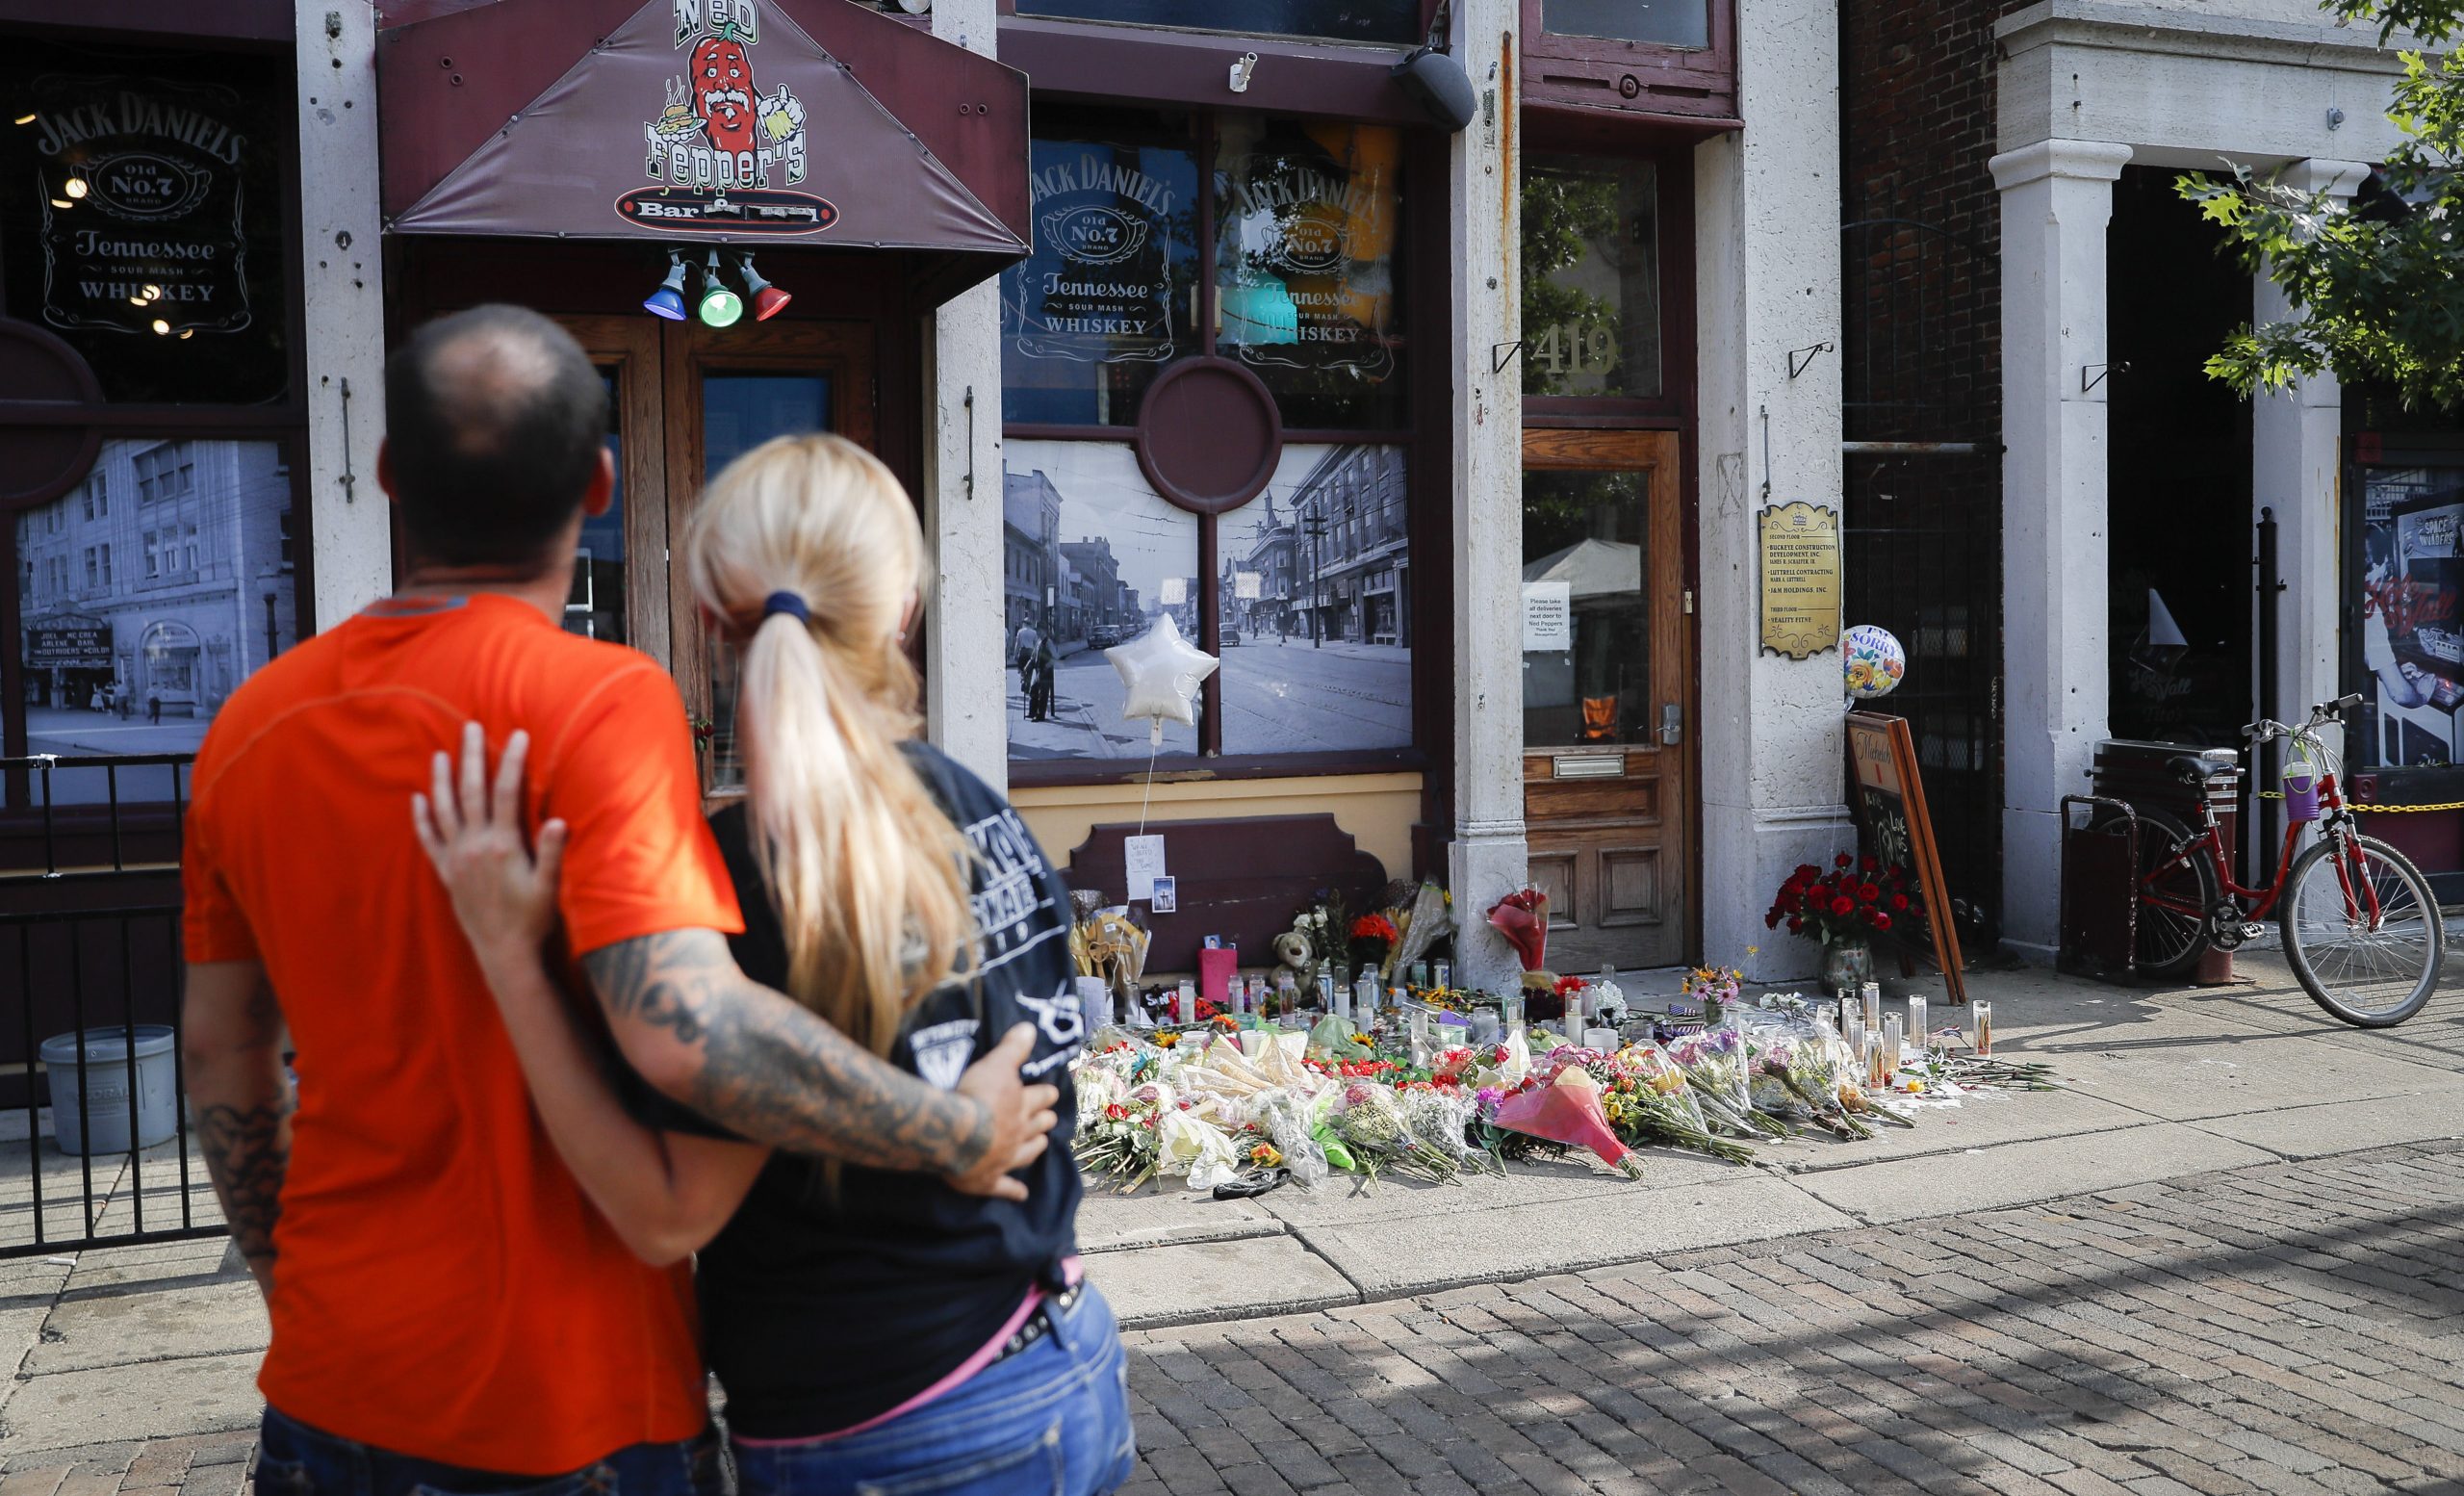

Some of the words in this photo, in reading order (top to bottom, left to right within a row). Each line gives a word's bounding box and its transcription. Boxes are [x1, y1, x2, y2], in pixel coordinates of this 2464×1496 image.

[38, 101, 117, 156] JACK
[124, 164, 157, 176] Old
[1081, 153, 1176, 217] DANIEL'S
[1237, 174, 1296, 220] JACK
[636, 201, 700, 219] Bar
[1082, 216, 1106, 226] Old
[1299, 228, 1322, 237] Old
[75, 230, 217, 260] Tennessee
[111, 266, 143, 275] SOUR
[149, 266, 184, 276] MASH
[79, 281, 216, 302] WHISKEY
[1042, 272, 1148, 298] Tennessee
[1068, 303, 1093, 312] SOUR
[1098, 304, 1124, 313] MASH
[1314, 312, 1338, 321] MASH
[1044, 317, 1147, 335] WHISKEY
[1280, 326, 1359, 342] ISKEY
[1531, 323, 1617, 375] 419
[2425, 519, 2449, 534] SPACE
[2419, 531, 2454, 547] INVADERS
[40, 632, 58, 640] JOEL
[41, 639, 67, 648] ARLENE
[1850, 632, 1895, 657] SORRY
